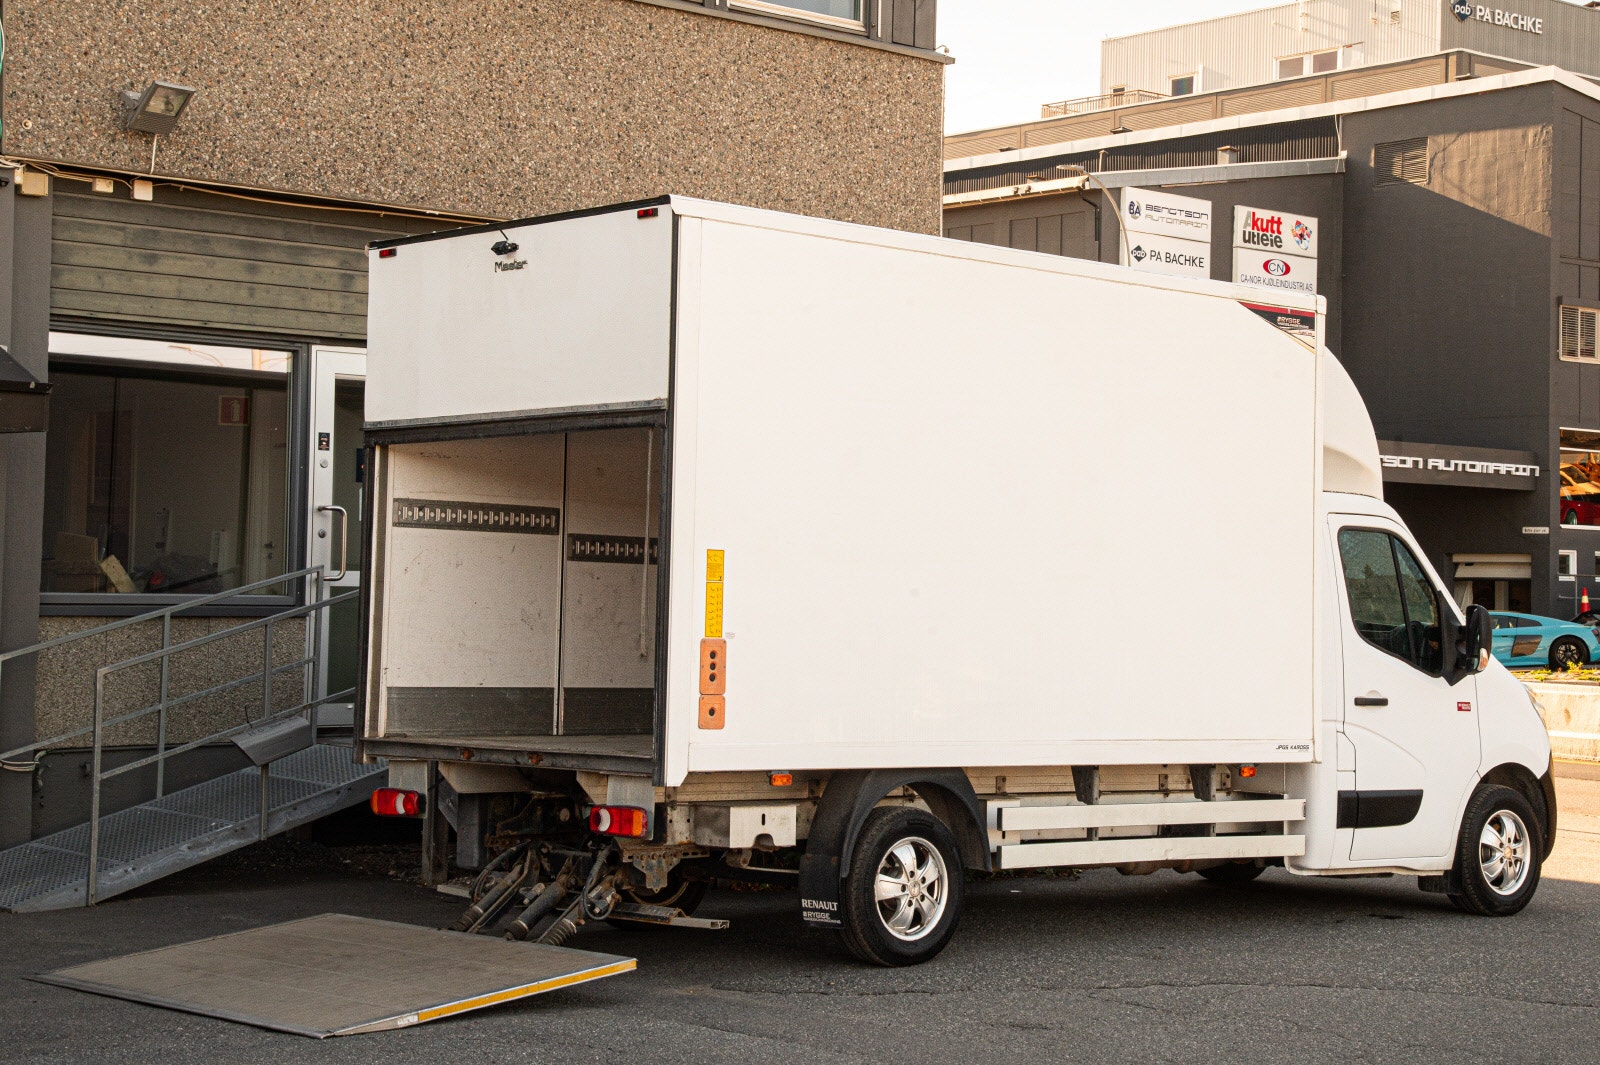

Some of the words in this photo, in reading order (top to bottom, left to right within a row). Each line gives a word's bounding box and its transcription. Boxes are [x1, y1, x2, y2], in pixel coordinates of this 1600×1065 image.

[1454, 3, 1471, 15] pab
[1476, 5, 1492, 23] PA
[1494, 9, 1543, 34] BACHKE
[1145, 203, 1209, 220] BENGTSON
[1144, 214, 1208, 229] AUTOMARIN
[1243, 210, 1283, 235] Akutt
[1242, 230, 1283, 249] utleie
[494, 258, 528, 273] Master
[1149, 249, 1162, 263] PA
[1165, 252, 1205, 268] BACHKE
[1269, 262, 1284, 273] CN
[1305, 283, 1314, 292] AS
[1427, 458, 1540, 477] AUTOMARIN
[801, 898, 839, 911] RENAULT
